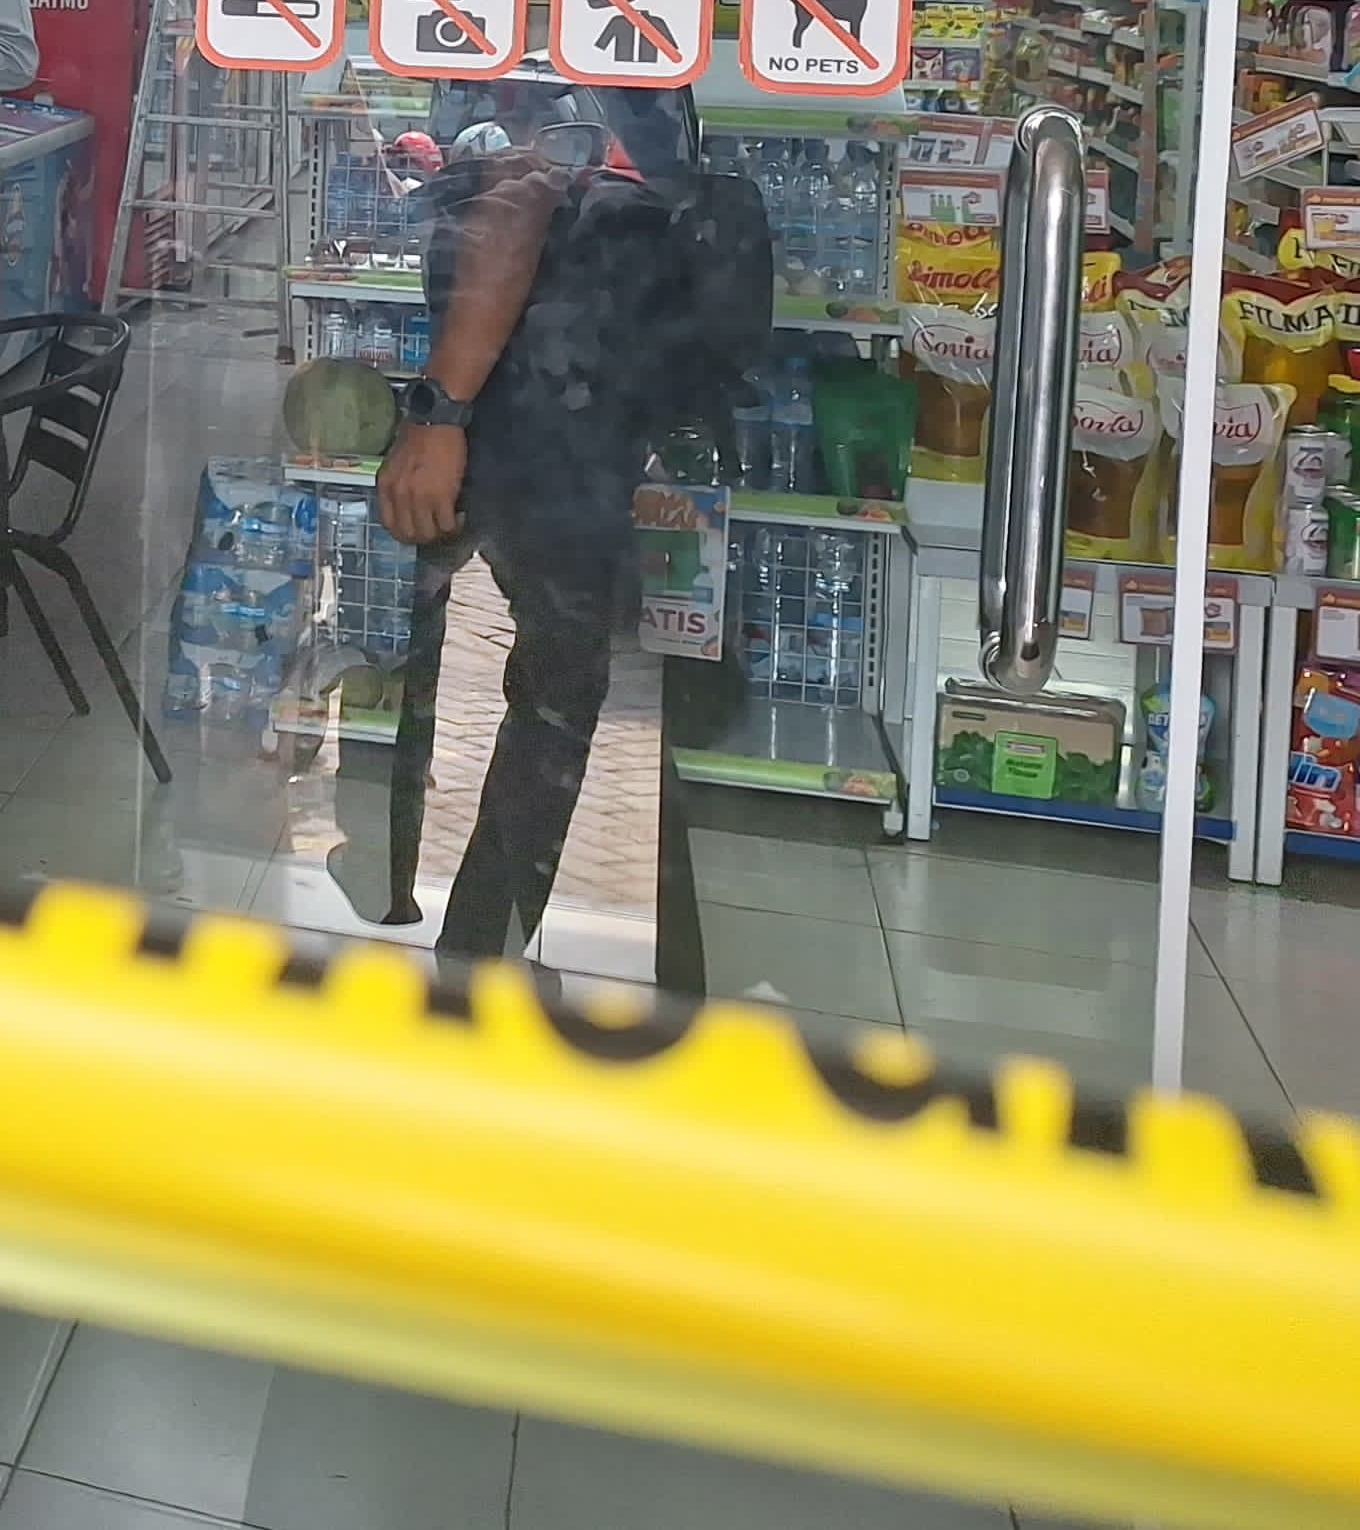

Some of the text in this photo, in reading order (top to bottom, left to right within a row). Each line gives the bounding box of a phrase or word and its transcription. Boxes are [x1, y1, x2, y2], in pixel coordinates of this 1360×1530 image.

[769, 57, 860, 74] NO PETS
[642, 605, 707, 635] ATIS
